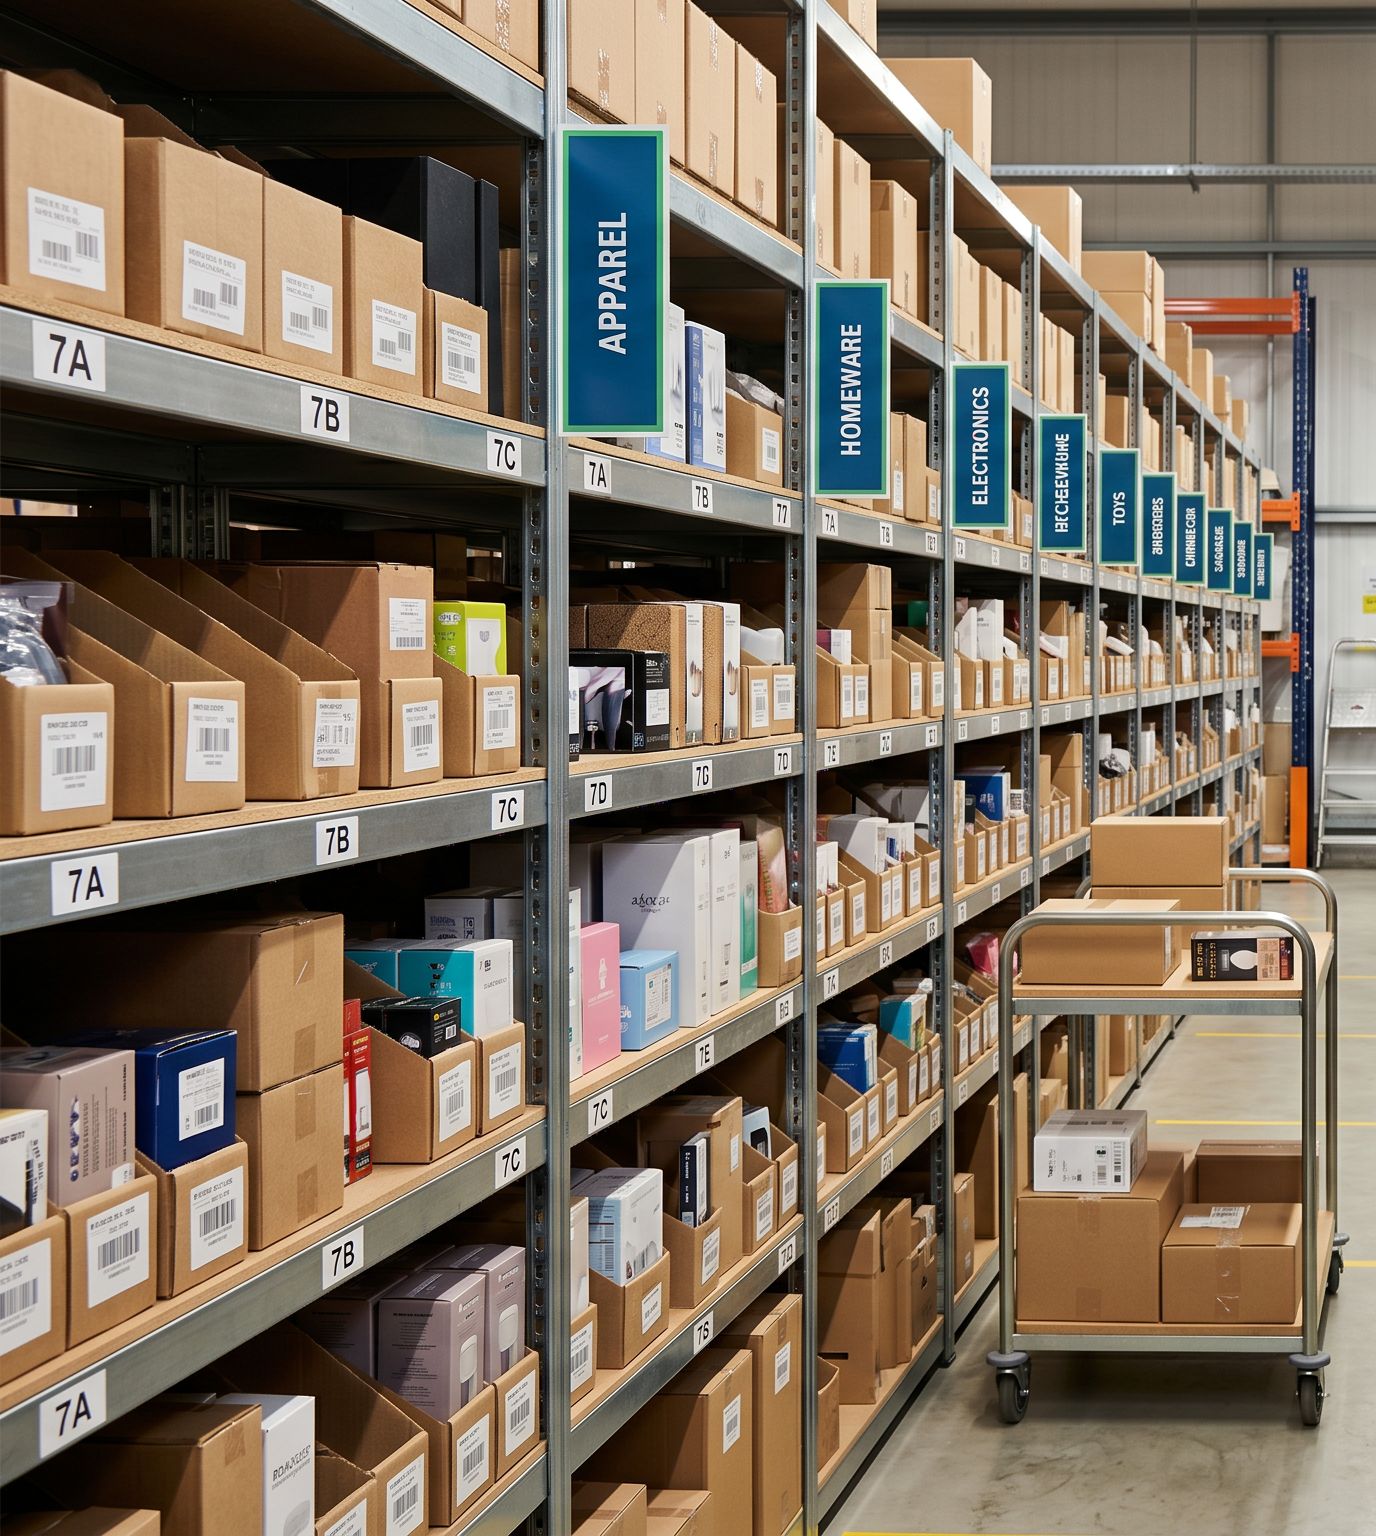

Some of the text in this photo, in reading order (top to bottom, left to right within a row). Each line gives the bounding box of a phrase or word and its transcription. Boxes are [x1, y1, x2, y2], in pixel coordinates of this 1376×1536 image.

[598, 212, 627, 355] APPAREL
[50, 334, 92, 380] 7A
[840, 324, 862, 456] HOMEWARE
[312, 396, 339, 432] 7B
[494, 439, 515, 470] 7C
[971, 386, 990, 505] ELECTRONICS
[589, 462, 606, 487] 7A
[696, 486, 709, 509] 7B
[1112, 491, 1126, 526] TOYS
[826, 513, 835, 532] 7A
[590, 782, 606, 805] 7D
[499, 798, 517, 822] 7C
[326, 826, 349, 855] 7B
[69, 866, 104, 903] 7A
[700, 1044, 711, 1067] 7E
[593, 1098, 608, 1127] 7C
[502, 1147, 520, 1177] 7C
[332, 1241, 354, 1276] 7B
[56, 1391, 91, 1437] 7A
